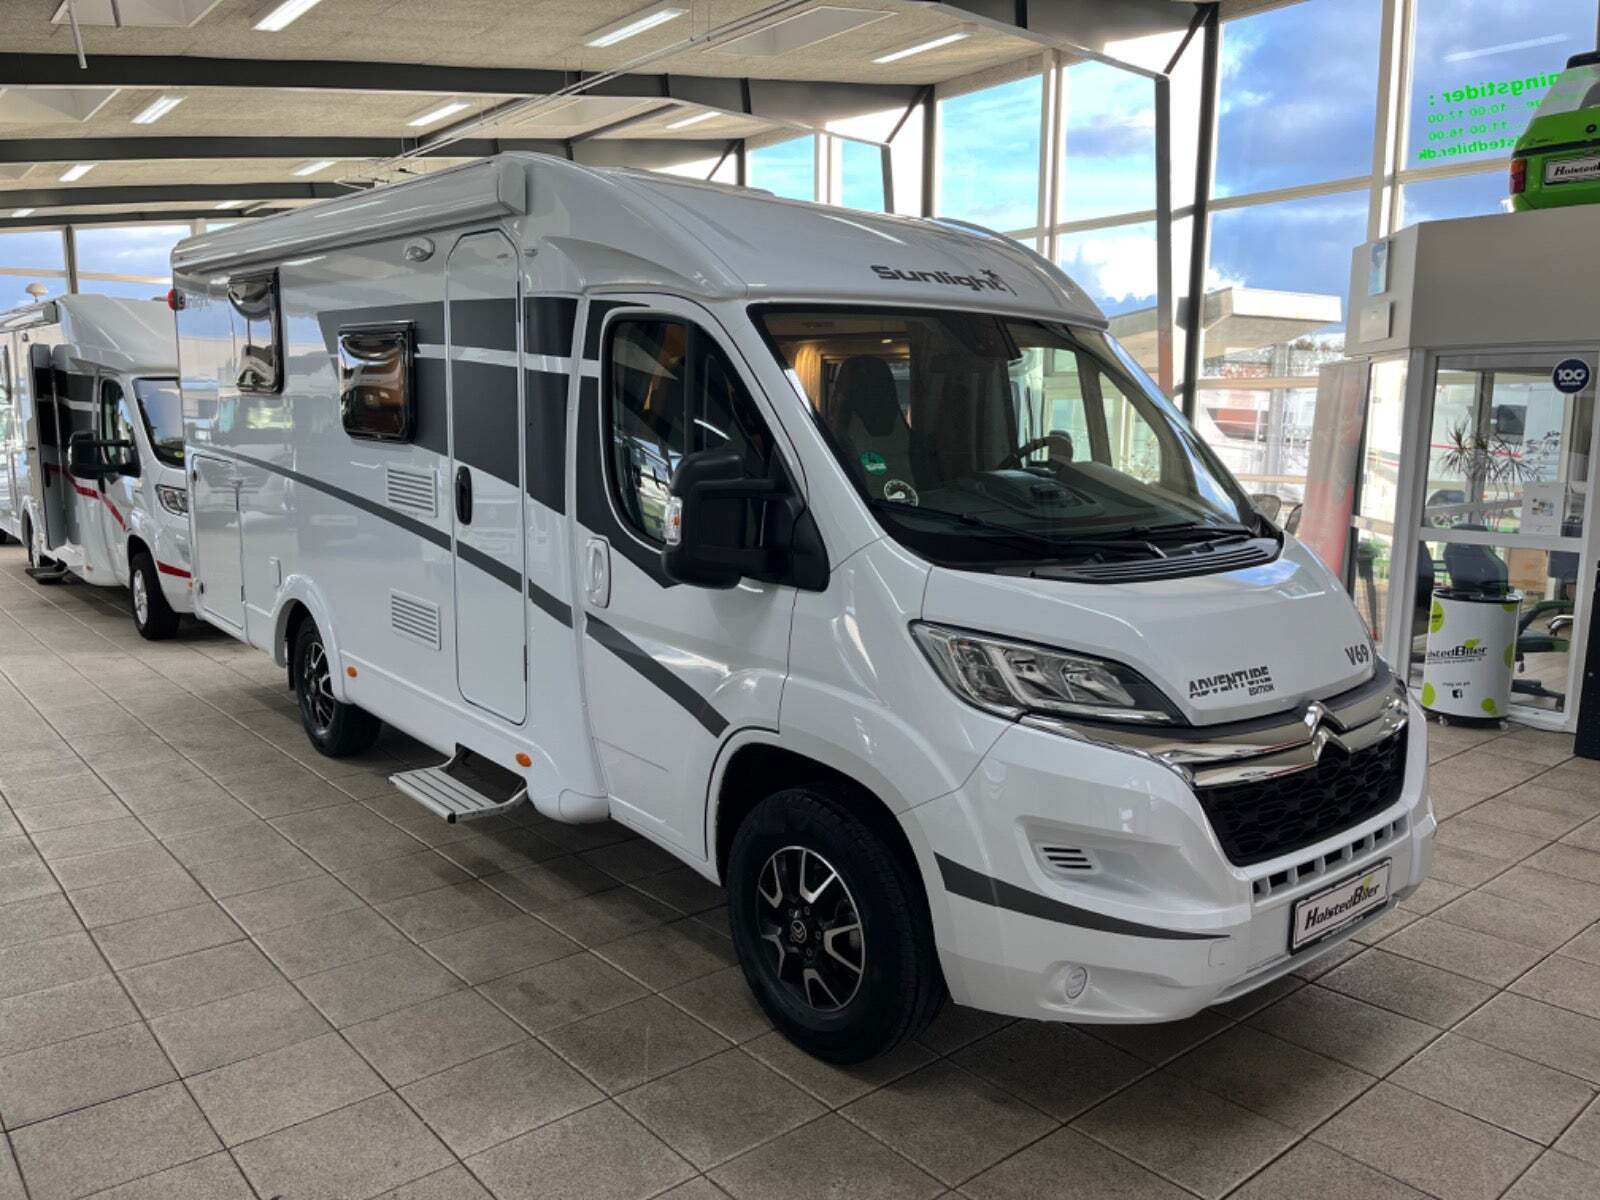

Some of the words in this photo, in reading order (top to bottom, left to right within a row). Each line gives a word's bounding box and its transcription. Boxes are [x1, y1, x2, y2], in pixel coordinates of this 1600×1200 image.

[1554, 162, 1600, 176] Holsted
[869, 264, 1008, 292] Sunlight
[1344, 644, 1369, 666] V69
[1188, 666, 1272, 699] ADVENTURE
